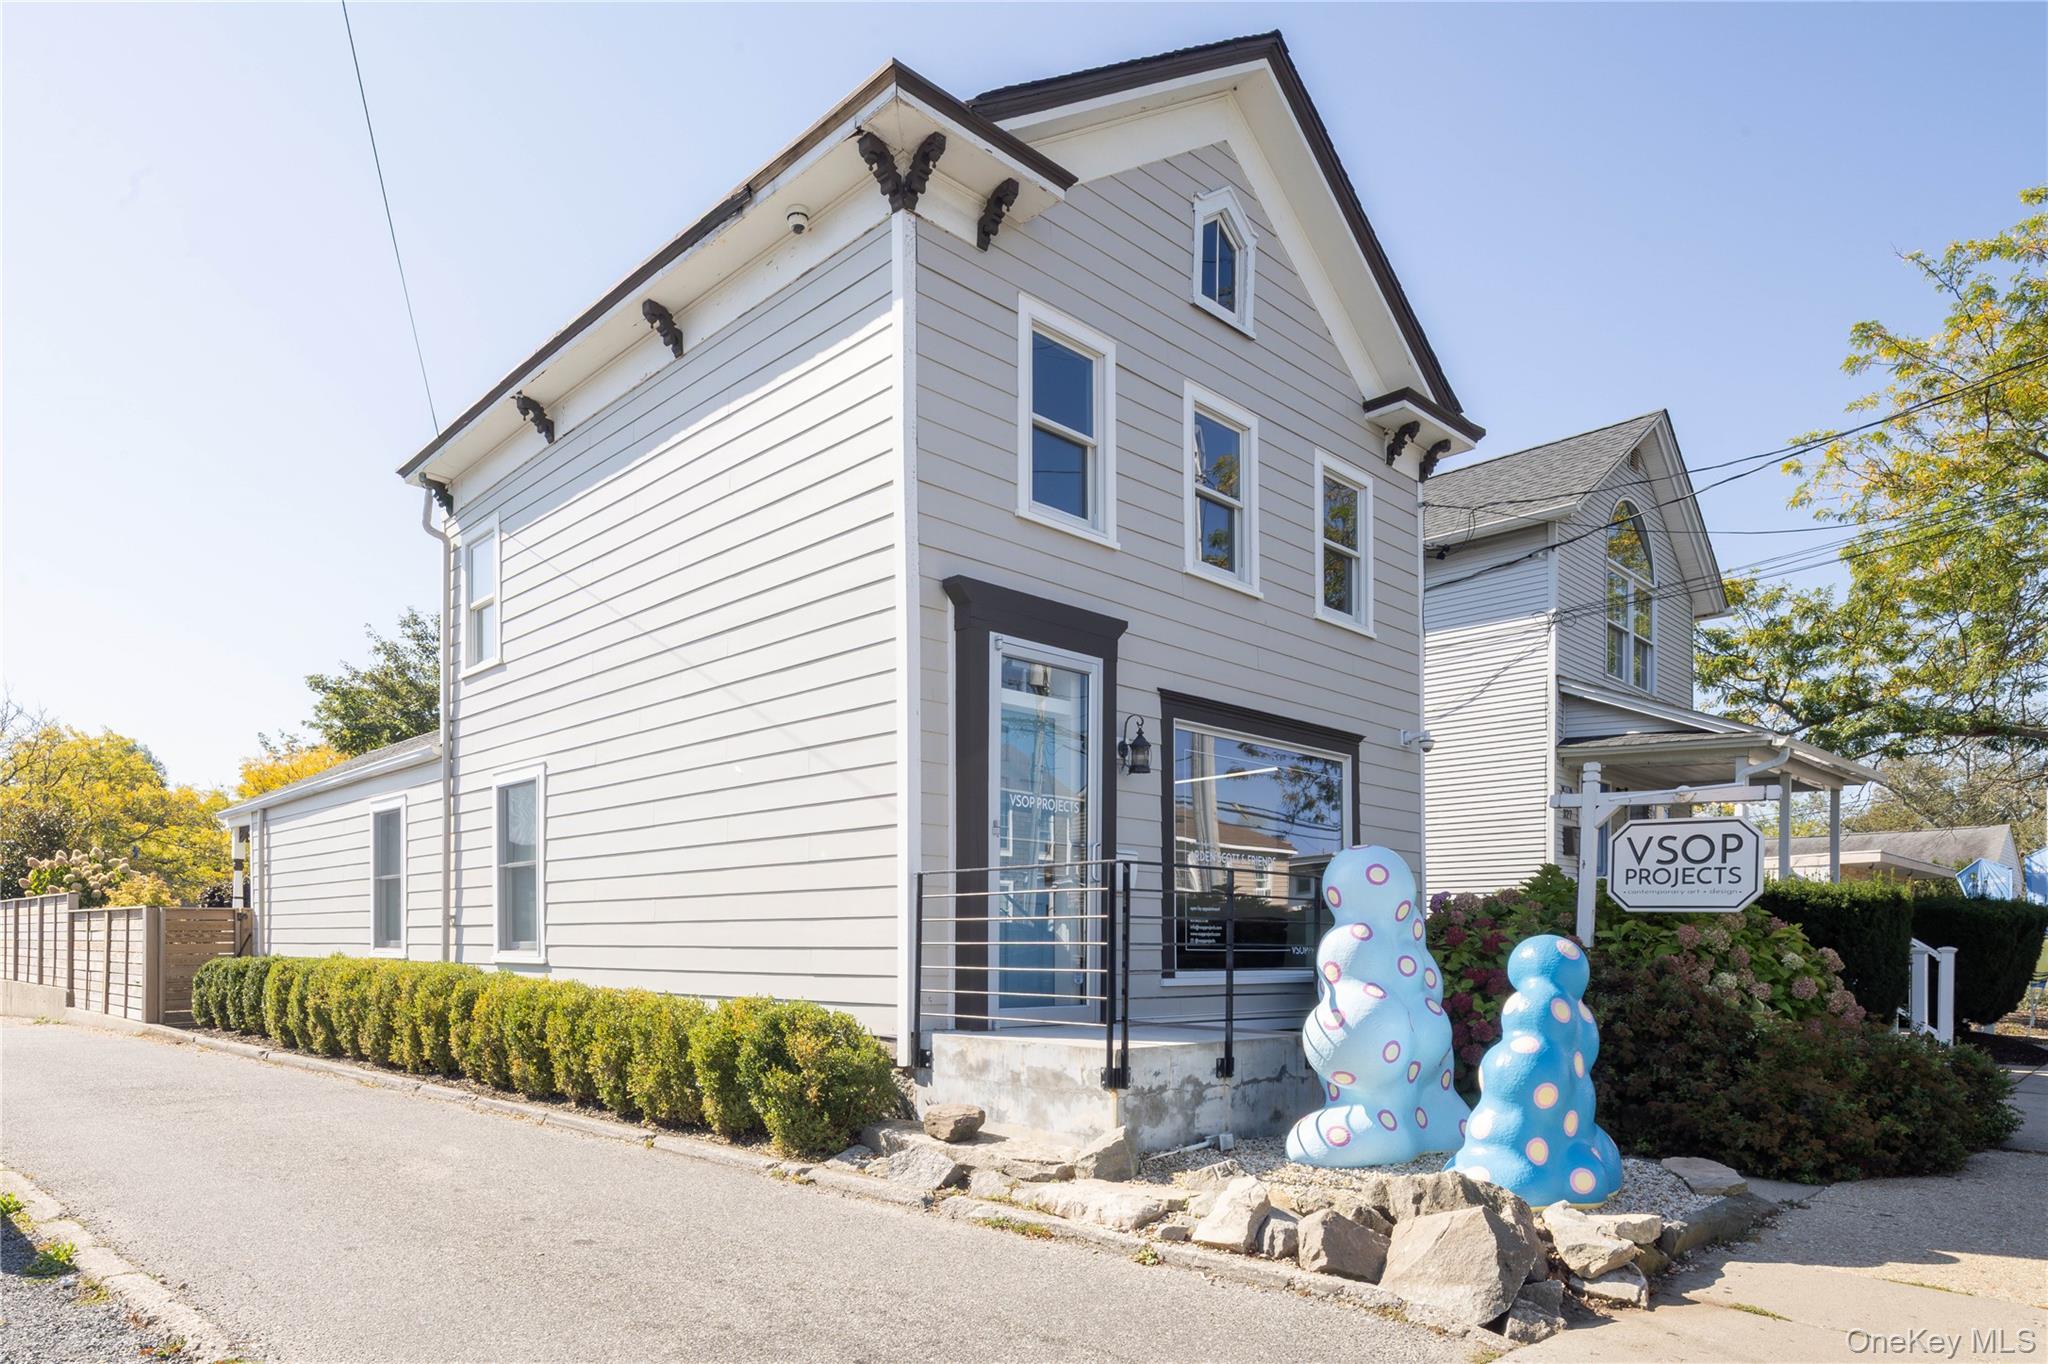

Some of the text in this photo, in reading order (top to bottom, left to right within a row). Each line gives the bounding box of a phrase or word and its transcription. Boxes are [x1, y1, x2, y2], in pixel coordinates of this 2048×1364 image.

[1009, 793, 1080, 814] VSOP PROJECTS
[1626, 833, 1744, 866] VSOP
[1625, 866, 1742, 888] PROJECTS
